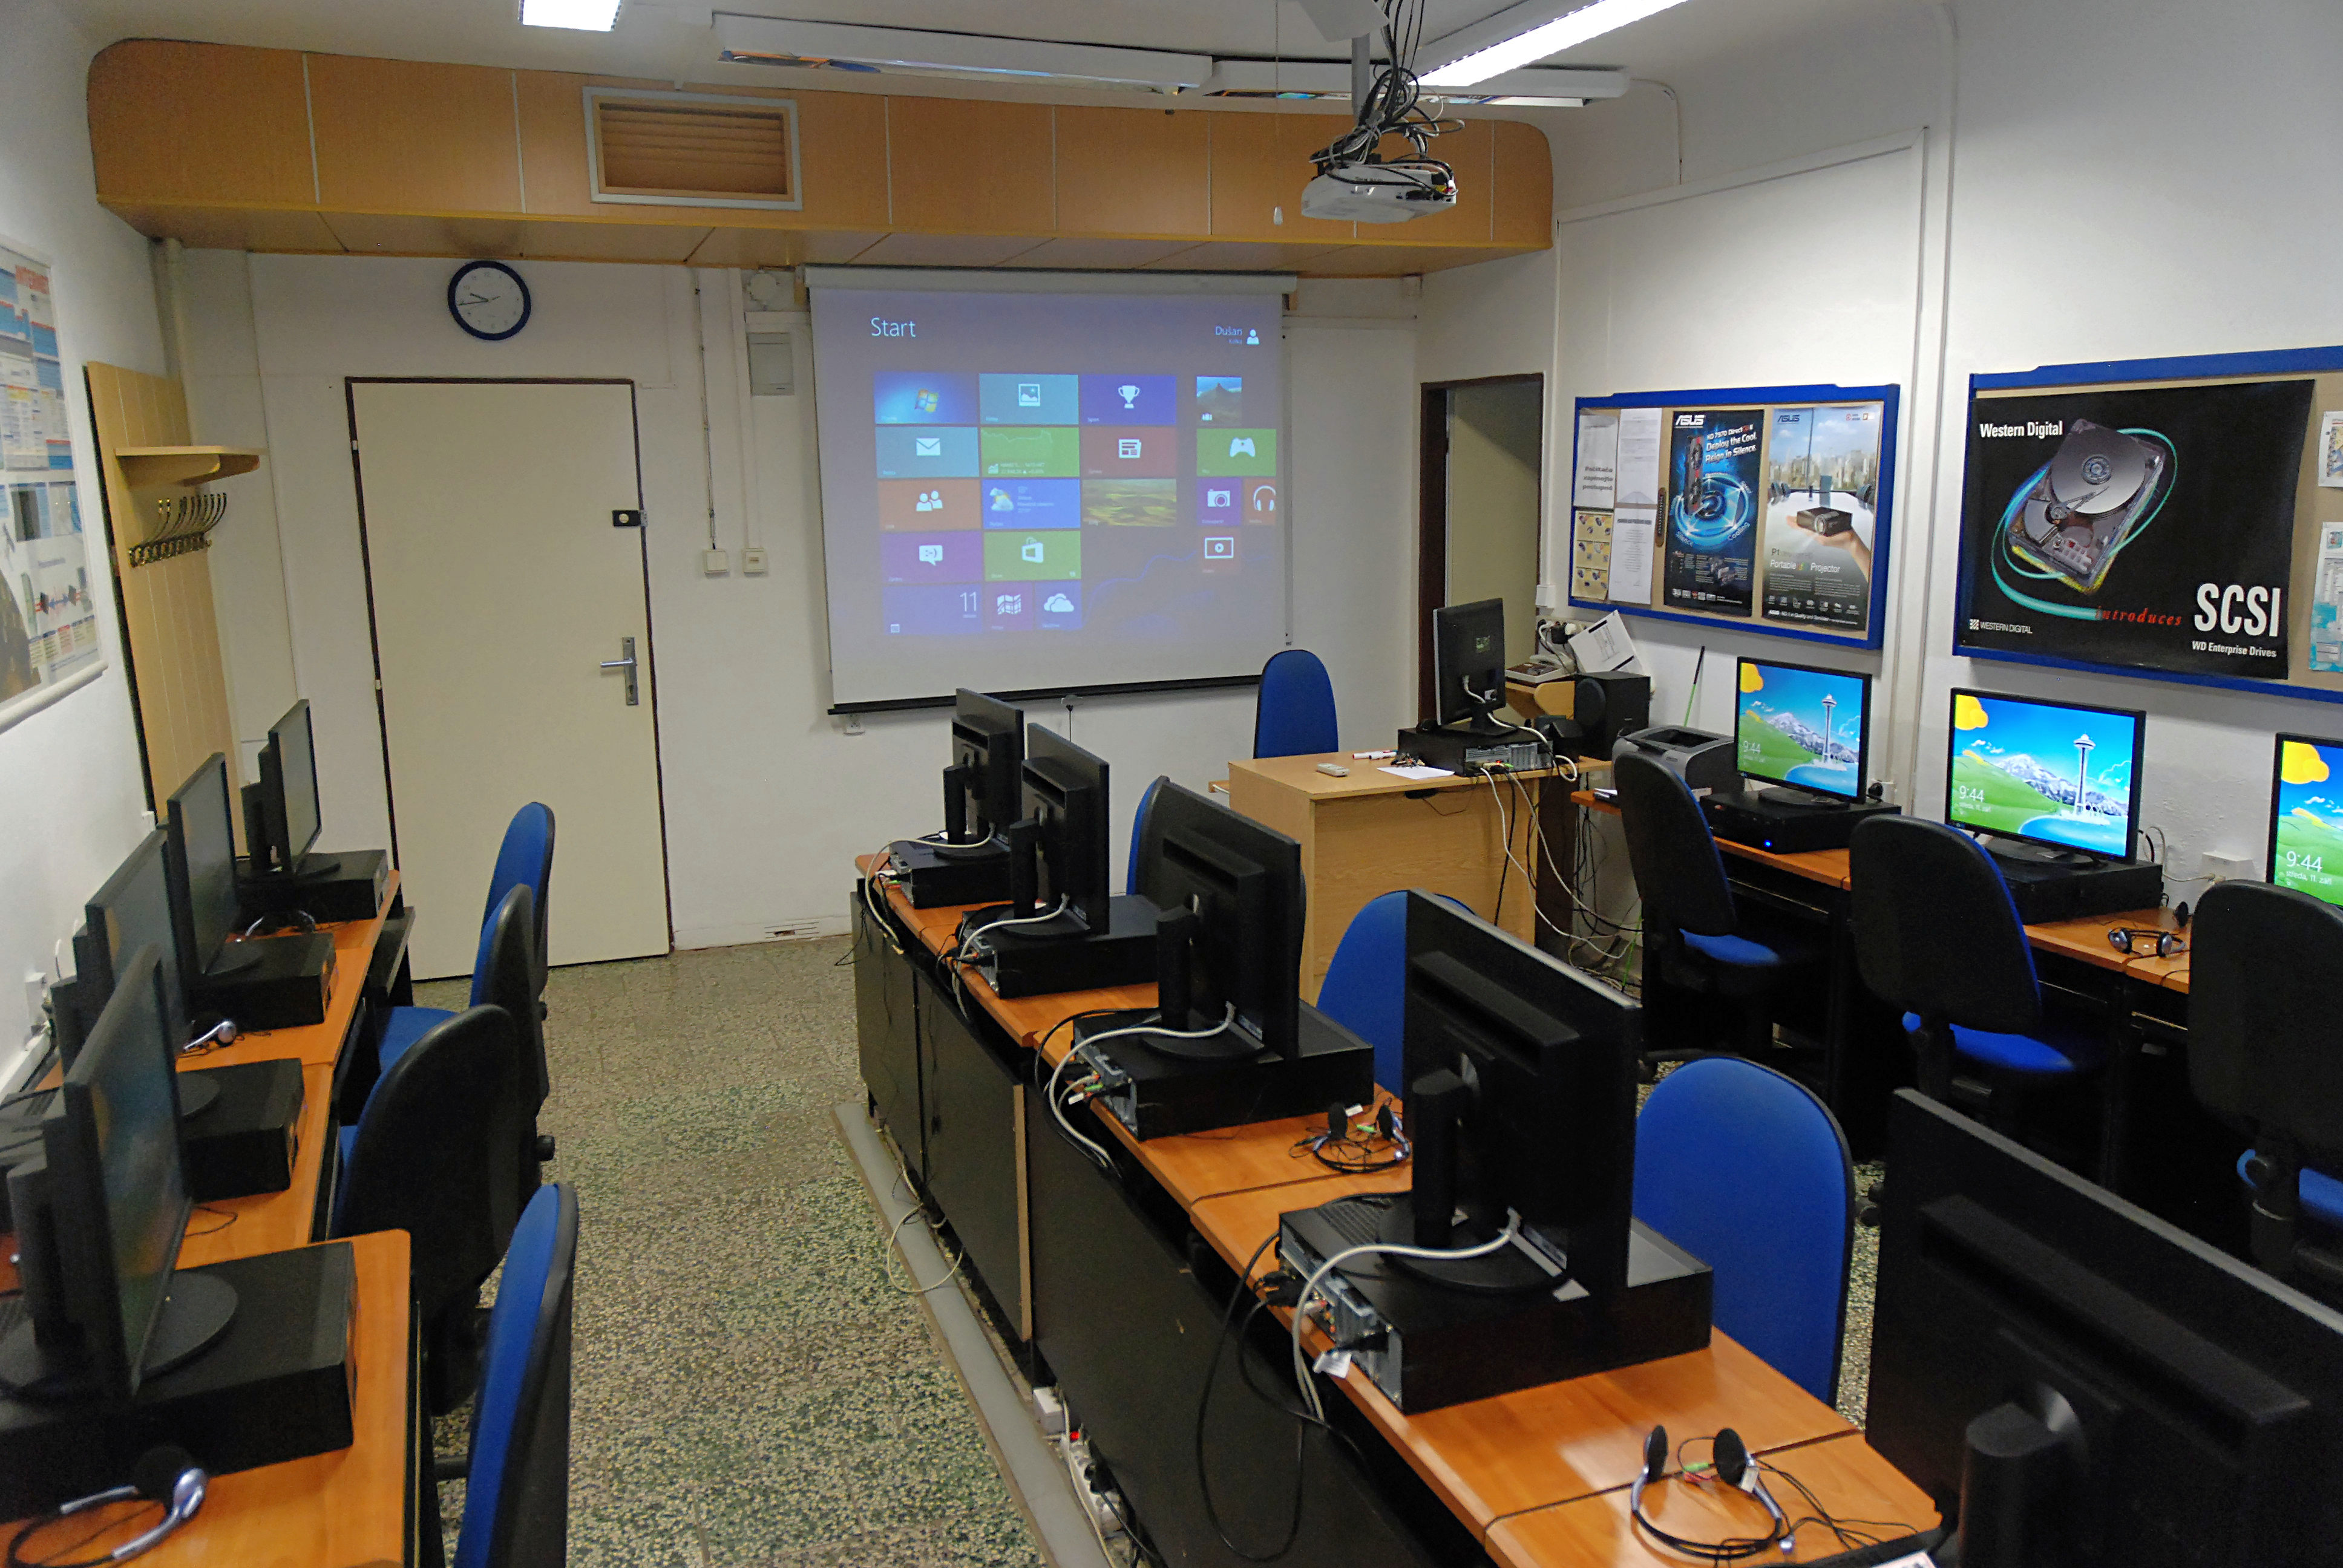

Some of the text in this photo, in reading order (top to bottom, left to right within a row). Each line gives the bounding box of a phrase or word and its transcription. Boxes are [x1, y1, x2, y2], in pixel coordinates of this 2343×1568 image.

[871, 317, 916, 338] Start
[1675, 414, 1705, 425] ASUS
[1979, 420, 2063, 439] Western Digital
[1706, 439, 1729, 451] Deploy
[1730, 436, 1741, 446] the
[1705, 452, 1725, 463] Reign
[1726, 449, 1732, 459] in
[1727, 521, 1751, 541] Cooling
[1771, 547, 1780, 556] P1
[1770, 559, 1797, 570] Portable
[1810, 563, 1841, 573] Projector
[960, 591, 977, 612] 11
[2194, 583, 2281, 637] SCSI
[2095, 606, 2183, 626] introduces
[1980, 621, 2033, 634] WESTERN DIGITAL
[2192, 640, 2277, 658] WD Enterprise Drives
[1743, 740, 1761, 754] 9:44
[1959, 785, 1984, 803] 9:44
[2287, 851, 2323, 872] 9:44
